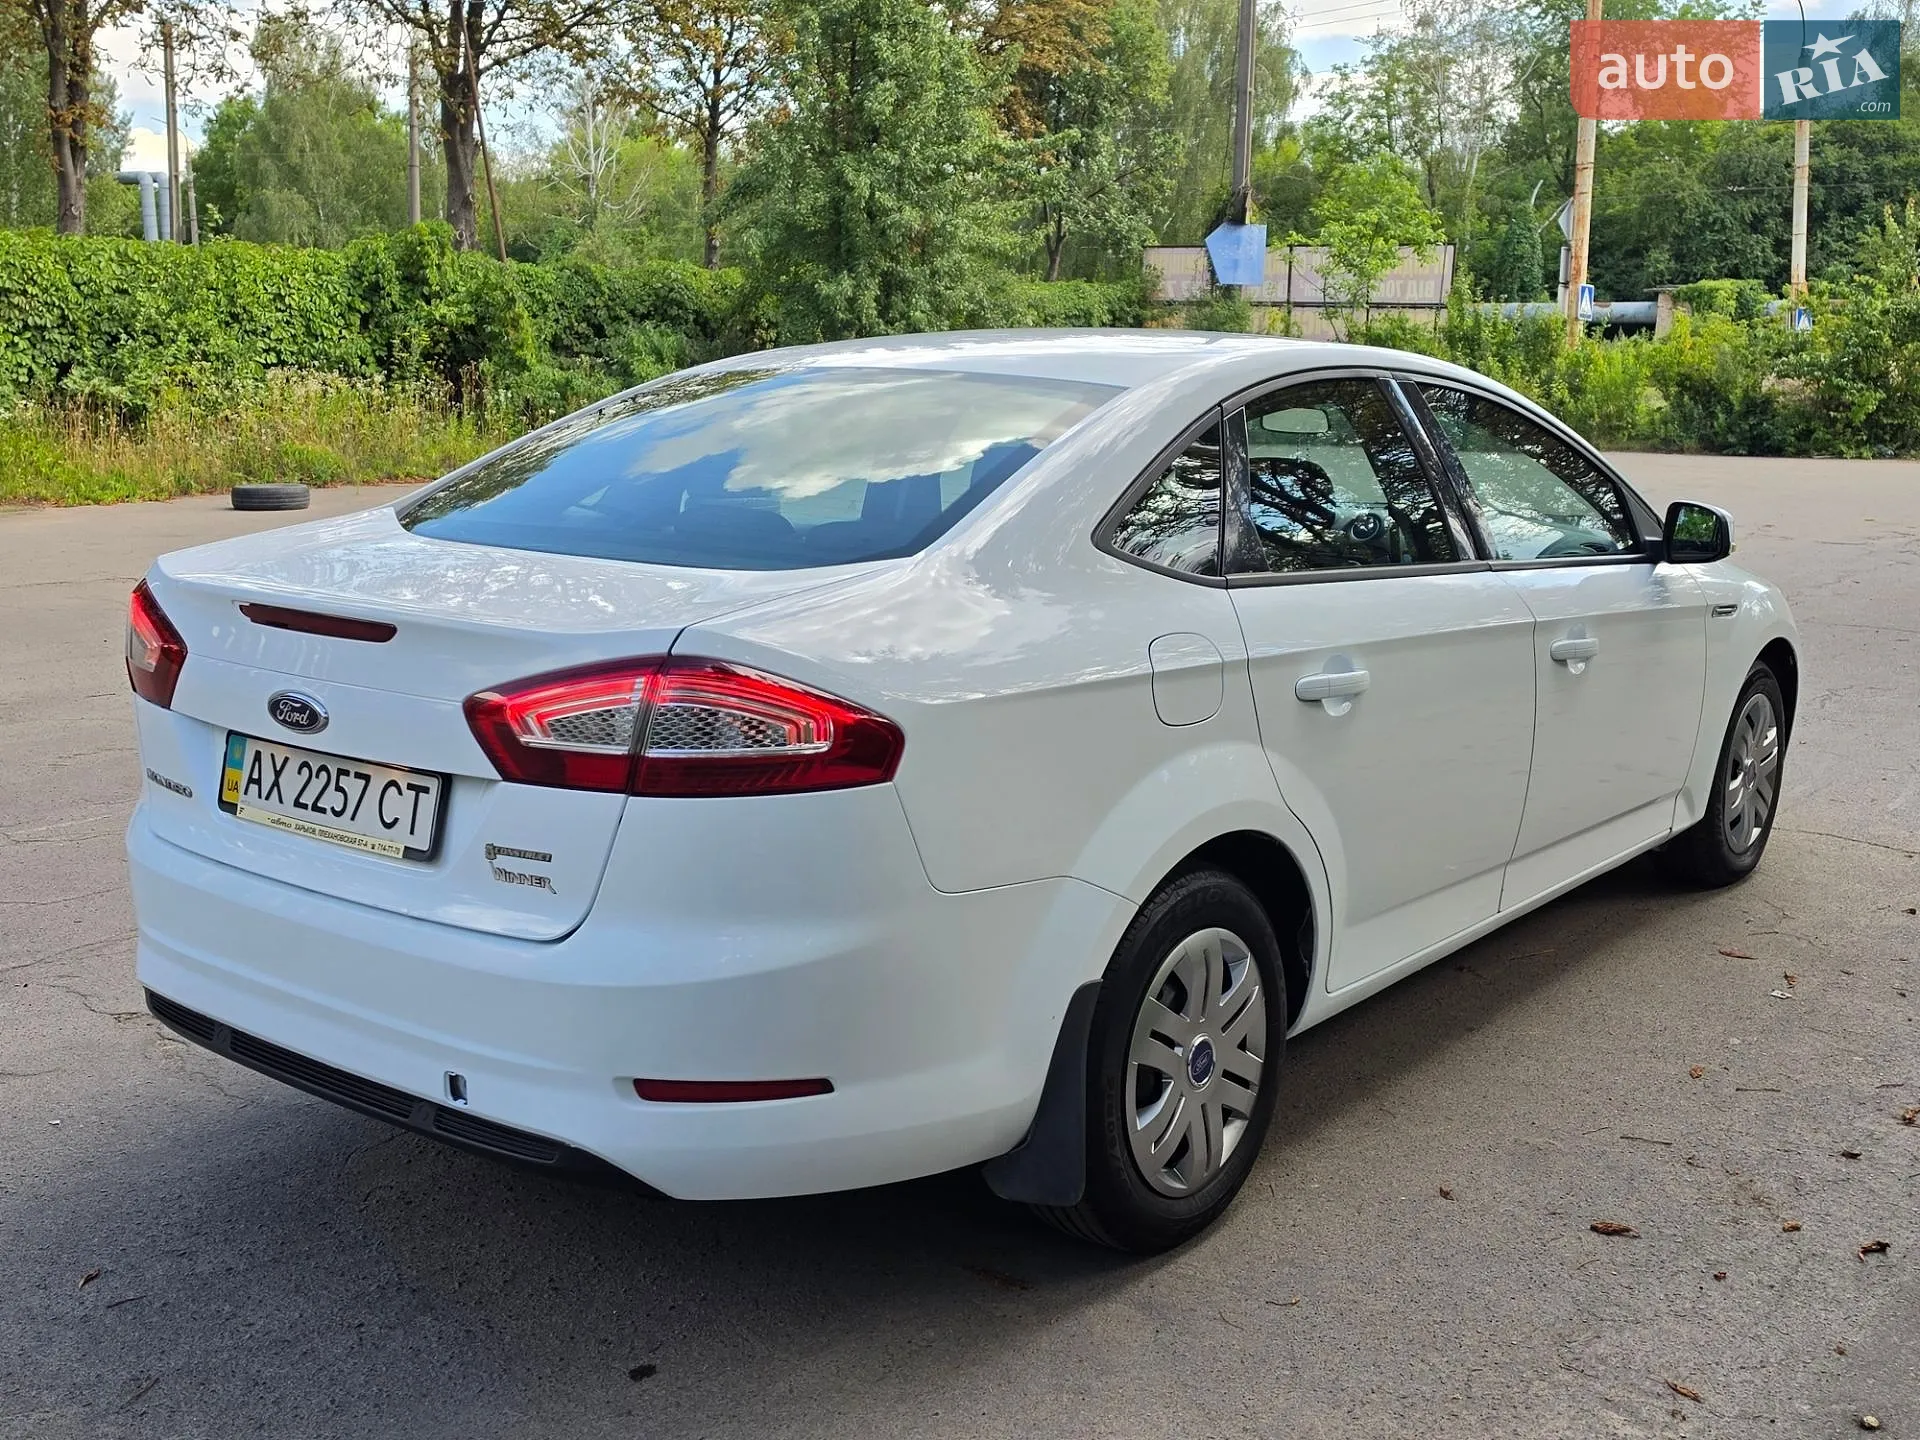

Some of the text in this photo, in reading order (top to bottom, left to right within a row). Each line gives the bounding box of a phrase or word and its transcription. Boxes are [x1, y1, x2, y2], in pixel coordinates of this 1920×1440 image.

[276, 699, 310, 725] Ford
[227, 779, 239, 793] UA
[243, 749, 430, 836] AX 2257 CT
